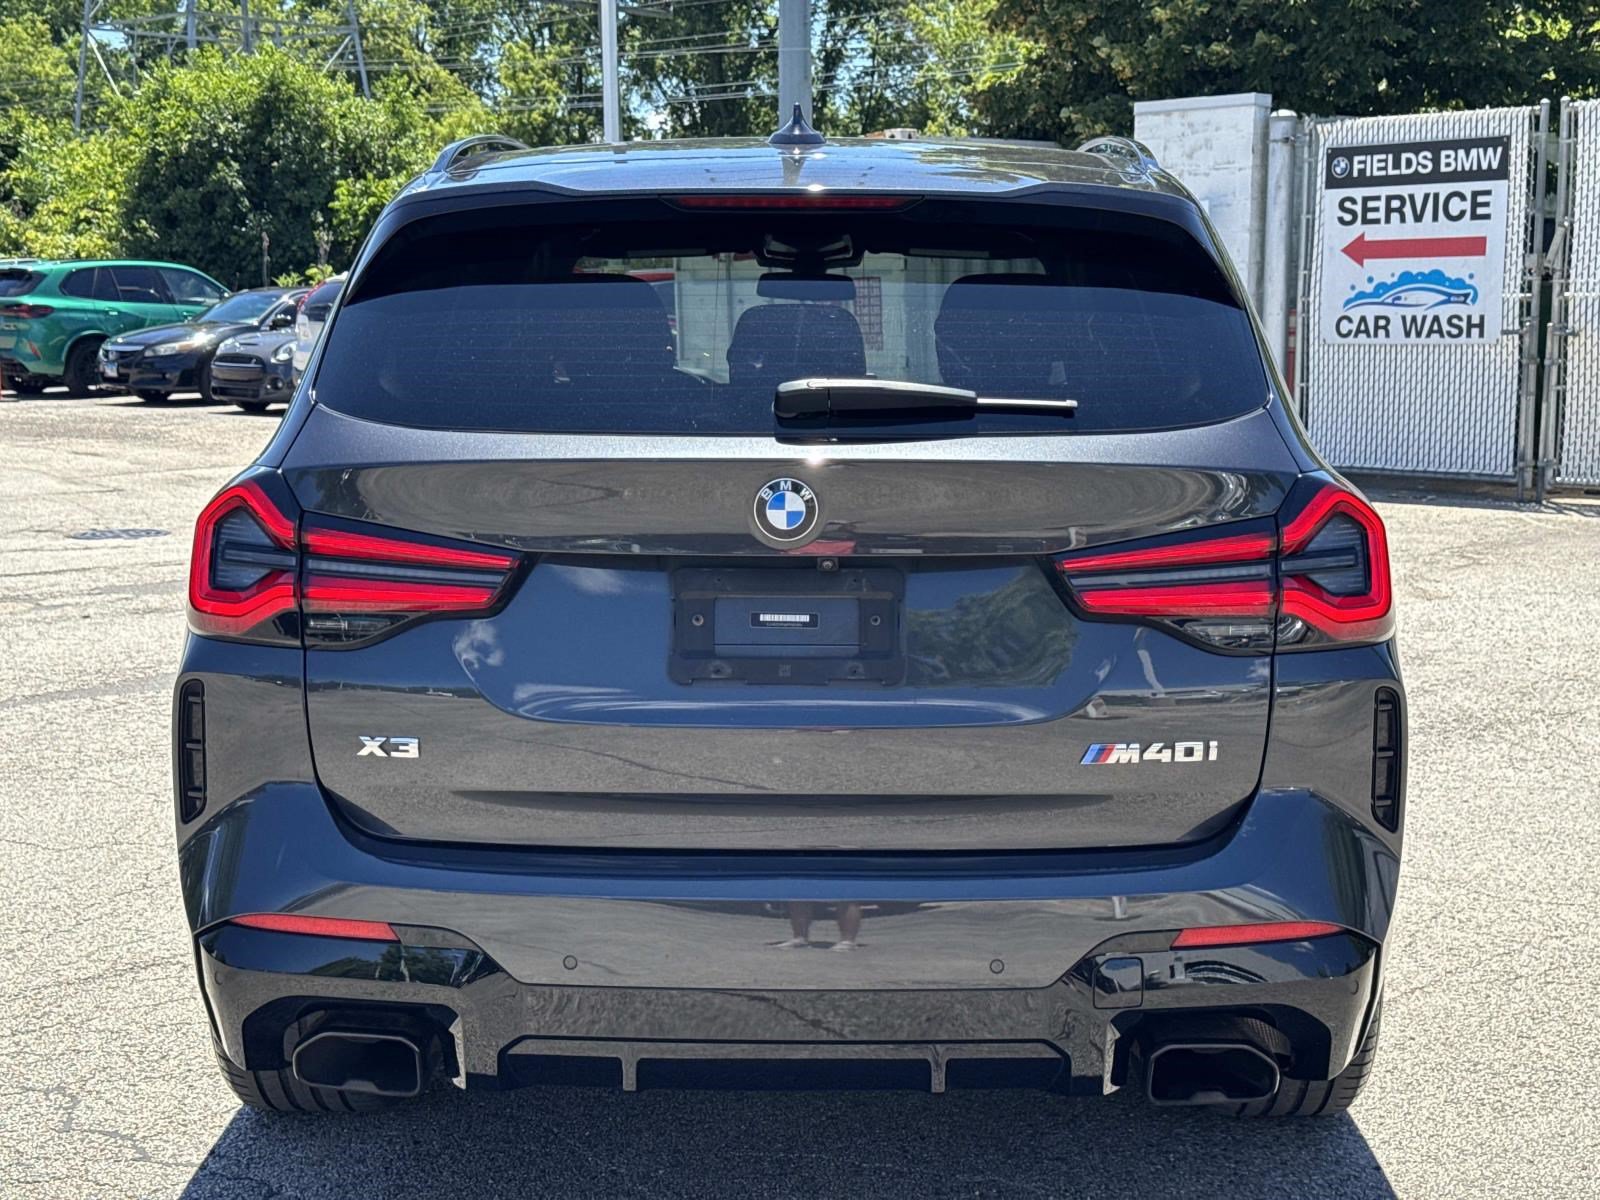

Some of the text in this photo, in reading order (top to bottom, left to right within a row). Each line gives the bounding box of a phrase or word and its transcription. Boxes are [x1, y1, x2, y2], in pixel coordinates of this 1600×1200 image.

[1352, 146, 1503, 177] FIELDS BMW
[1337, 189, 1493, 226] SERVICE
[1335, 314, 1485, 339] CAR WASH
[760, 480, 812, 501] BMW
[356, 735, 420, 758] X3
